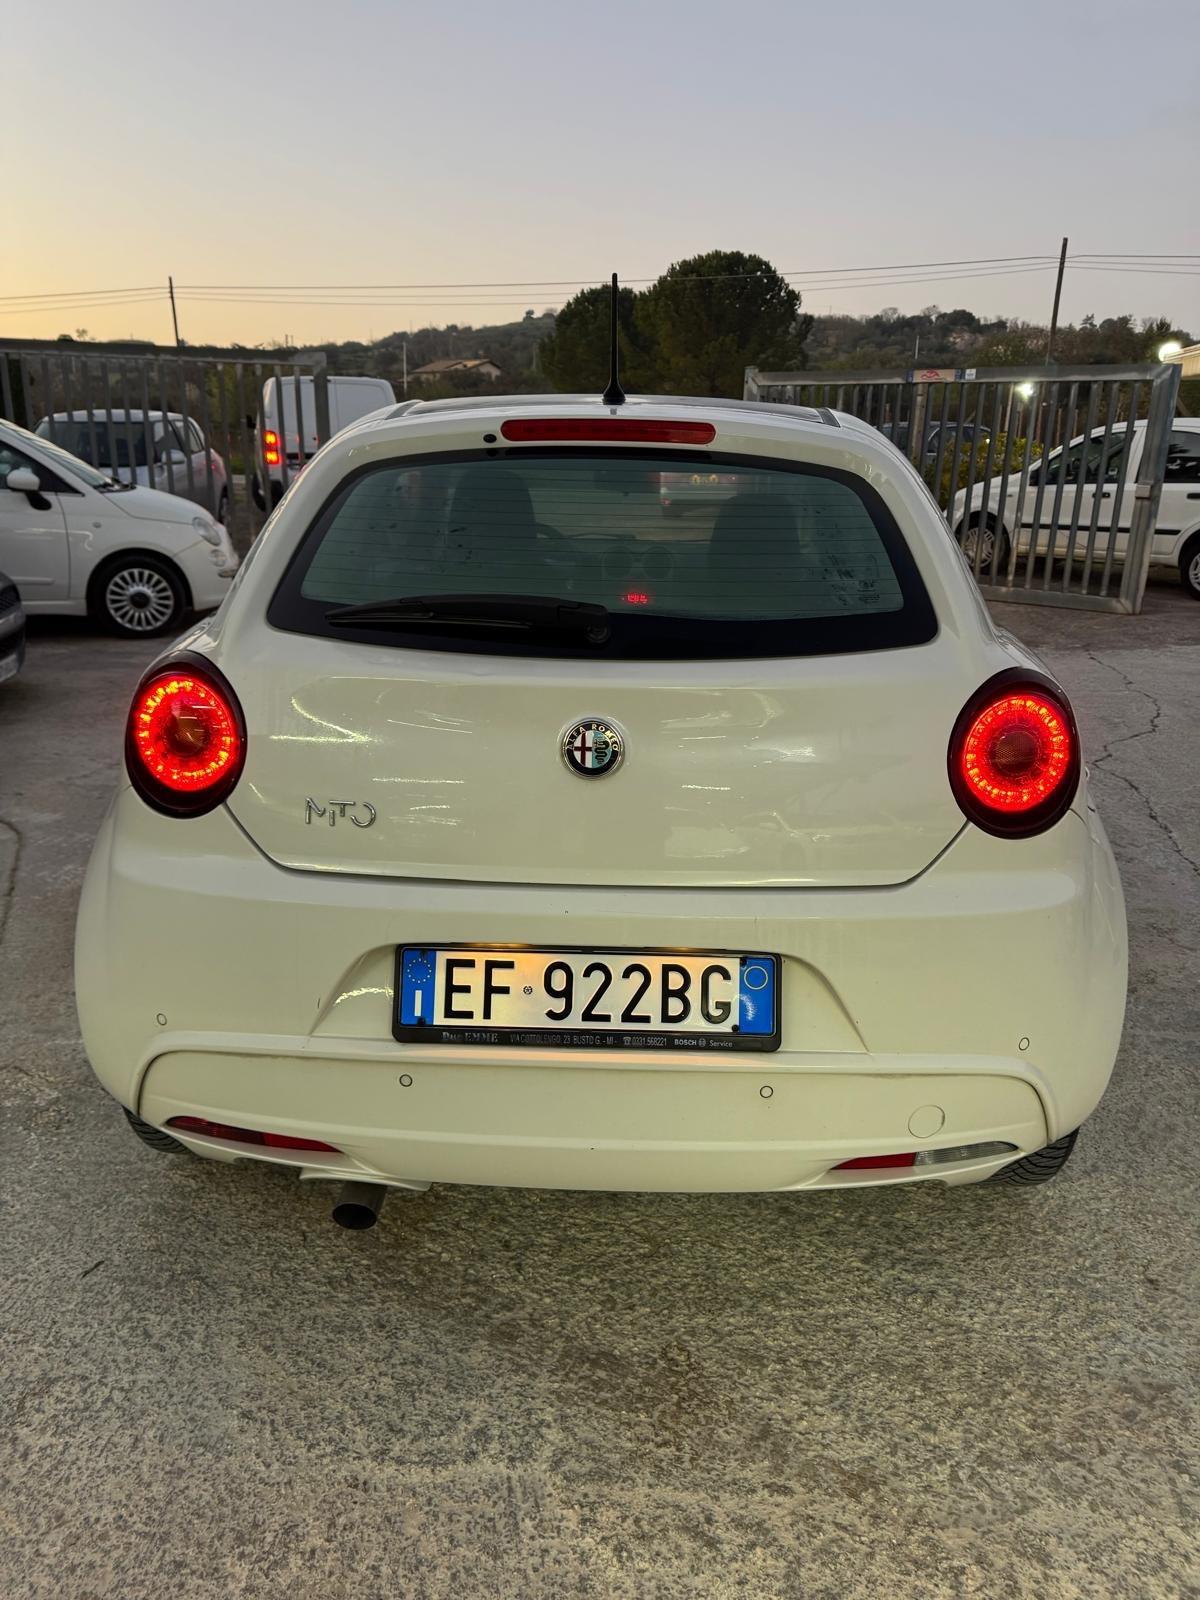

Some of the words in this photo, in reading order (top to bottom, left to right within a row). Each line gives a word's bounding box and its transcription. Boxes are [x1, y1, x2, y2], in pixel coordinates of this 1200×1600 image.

[566, 726, 586, 750] ALFA
[592, 723, 620, 752] ROMEO
[414, 989, 423, 1017] I
[444, 958, 515, 1020] EF
[543, 961, 732, 1025] 922BG
[674, 1038, 697, 1046] BOSCH
[709, 1039, 733, 1048] Service
